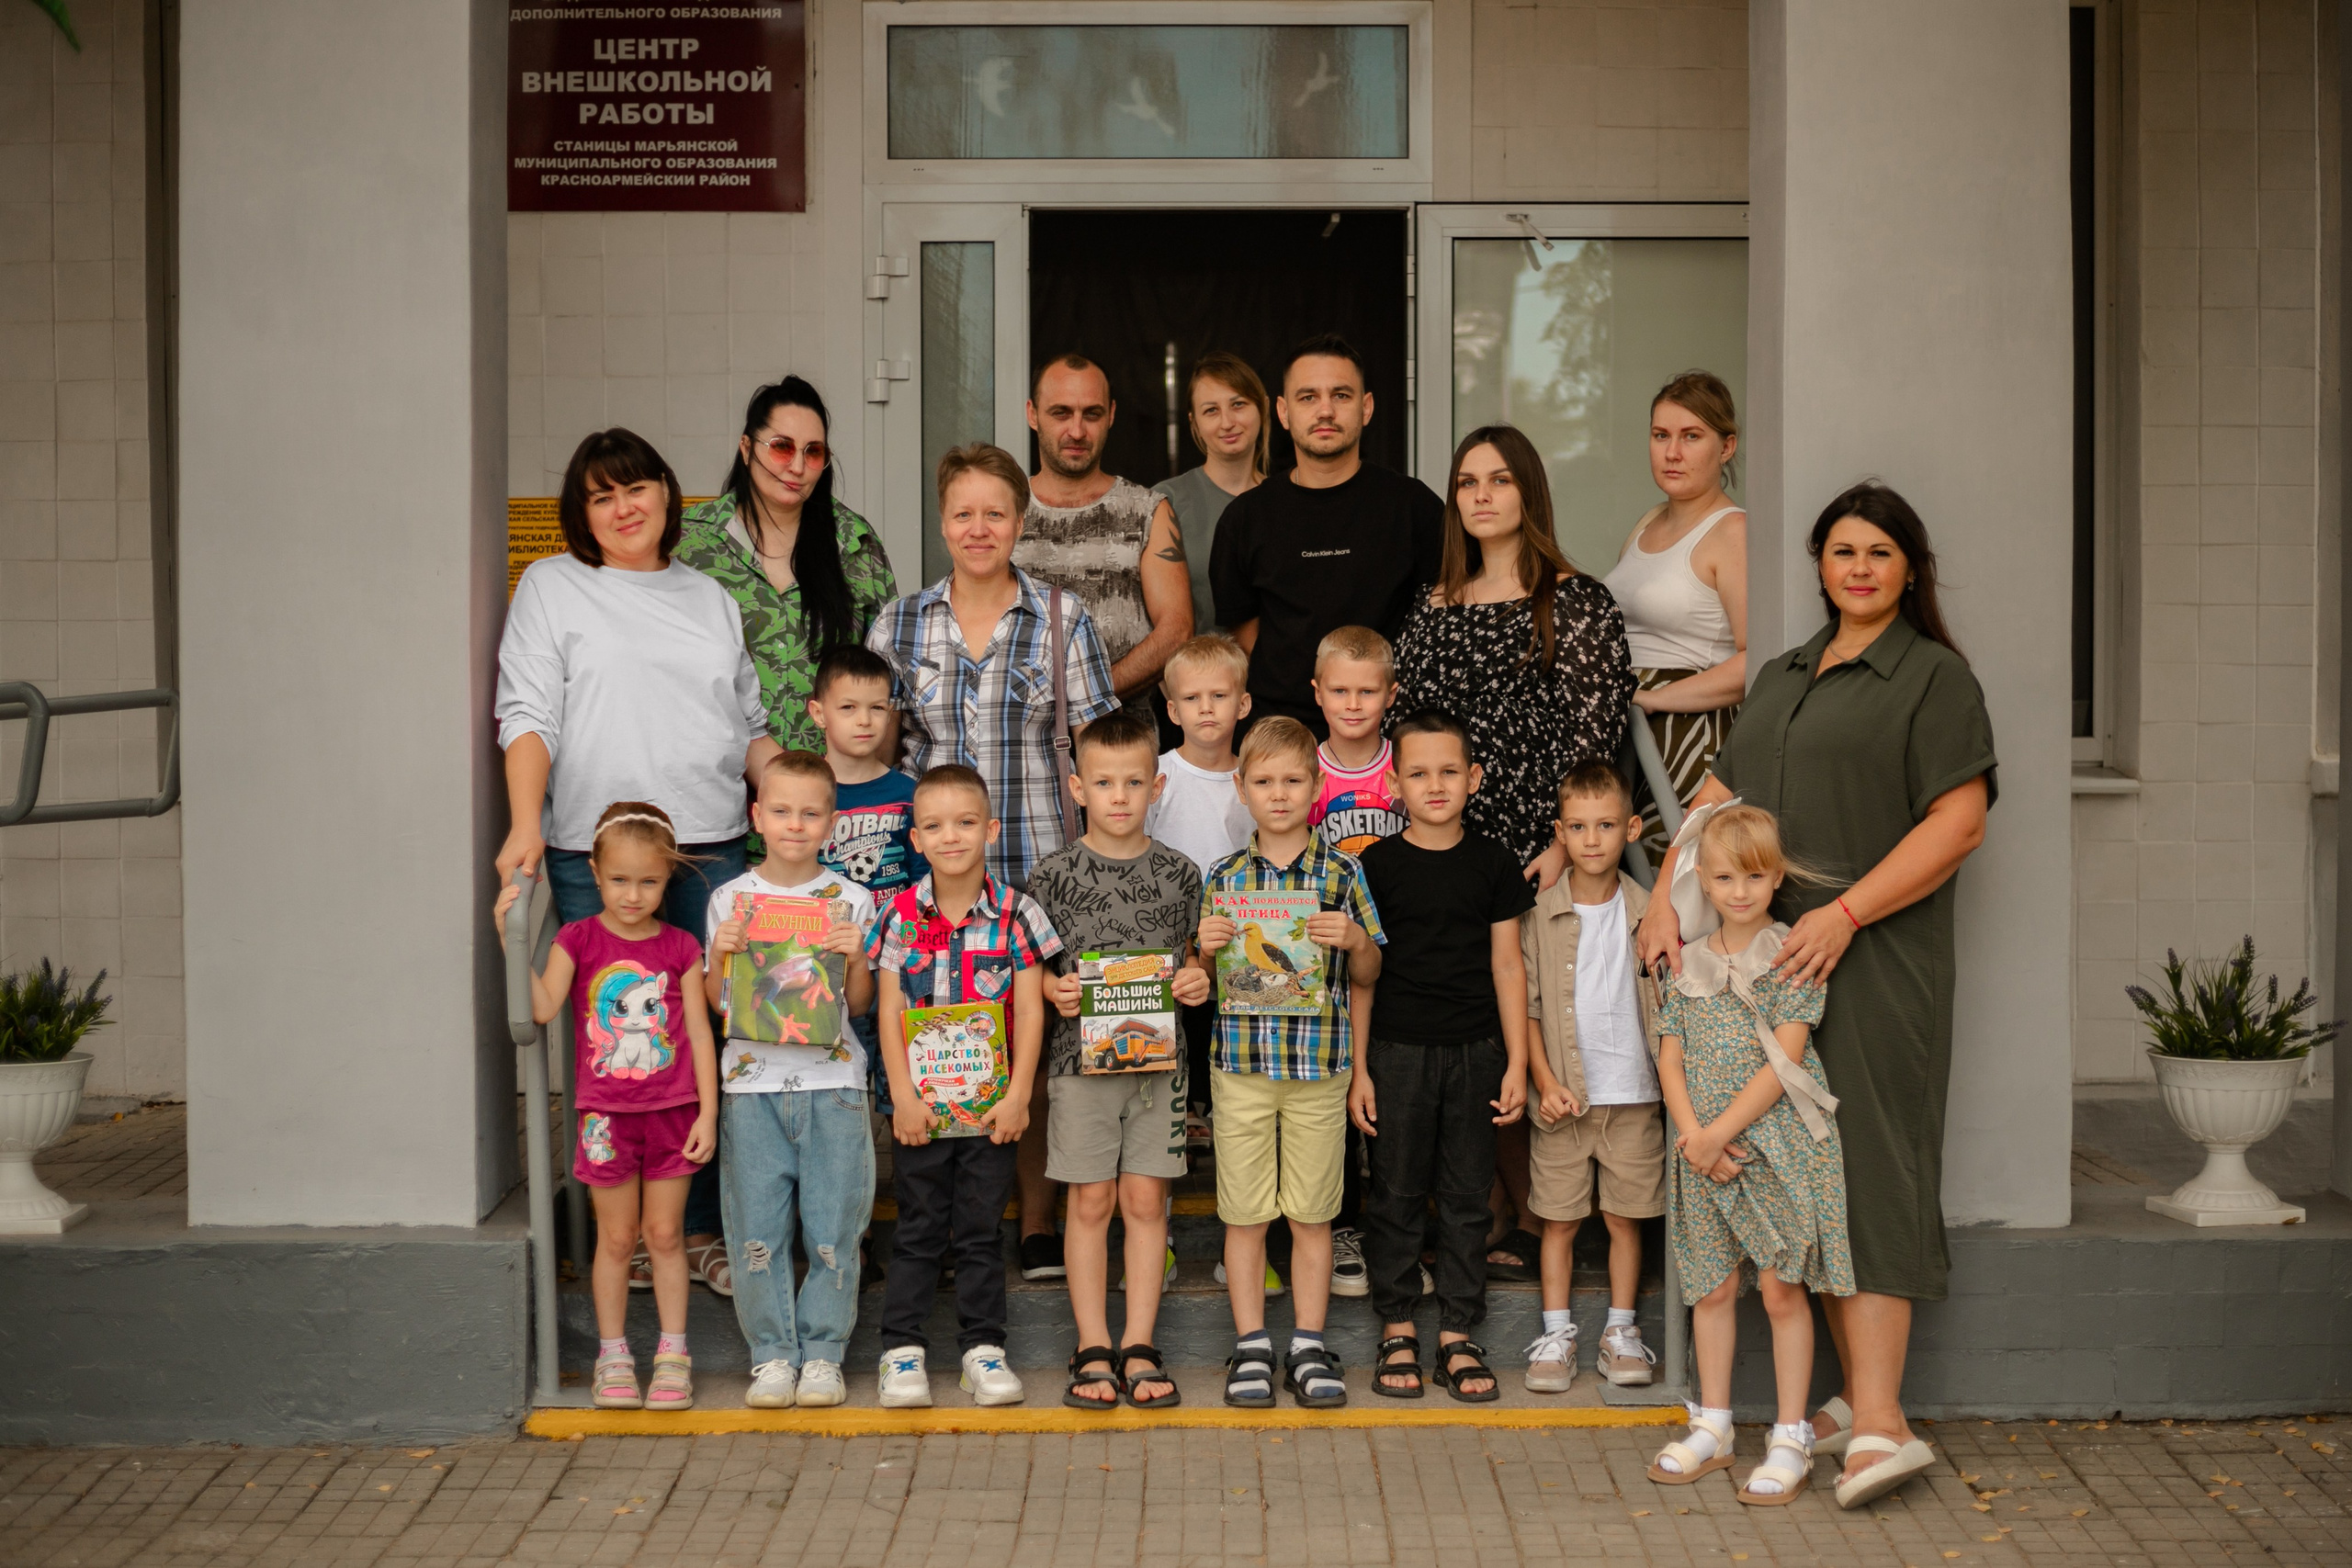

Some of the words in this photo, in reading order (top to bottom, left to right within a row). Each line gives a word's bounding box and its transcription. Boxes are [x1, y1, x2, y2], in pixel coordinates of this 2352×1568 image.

[510, 8, 666, 22] ДОПОЛНИТЕЛЬНОГО
[670, 7, 782, 19] ОБРАЗОВАНИЯ
[594, 39, 700, 64] ЦЕНТР
[522, 65, 773, 93] ВНЕШКОЛЬНОЙ
[579, 103, 715, 125] РАБОТЫ
[553, 141, 630, 153] СТАНИЦЫ
[634, 139, 739, 152] МАРЬЯНСКОЙ
[514, 157, 662, 171] МУНИЦИПАЛЬНОГО
[665, 157, 778, 169] ОБРАЗОВАНИЯ
[699, 173, 752, 186] РАЙОН
[1340, 794, 1371, 802] WONIKS
[820, 814, 906, 849] OTBALL
[824, 831, 892, 863] Champions
[881, 863, 900, 876] 1963
[877, 887, 898, 900] AND
[1114, 880, 1162, 904] WOW
[1214, 896, 1250, 906] КАК
[1252, 897, 1317, 906] ПОЯВЛЯЕТСЯ
[1237, 908, 1292, 919] ПТИЦА
[758, 913, 823, 931] ДЖУНГЛИ
[1093, 998, 1163, 1013] МАШИНЫ
[927, 1047, 981, 1063] ЦАРСТВО
[920, 1061, 991, 1076] НАСЕКОМЫХ
[1167, 1074, 1186, 1159] SURF
